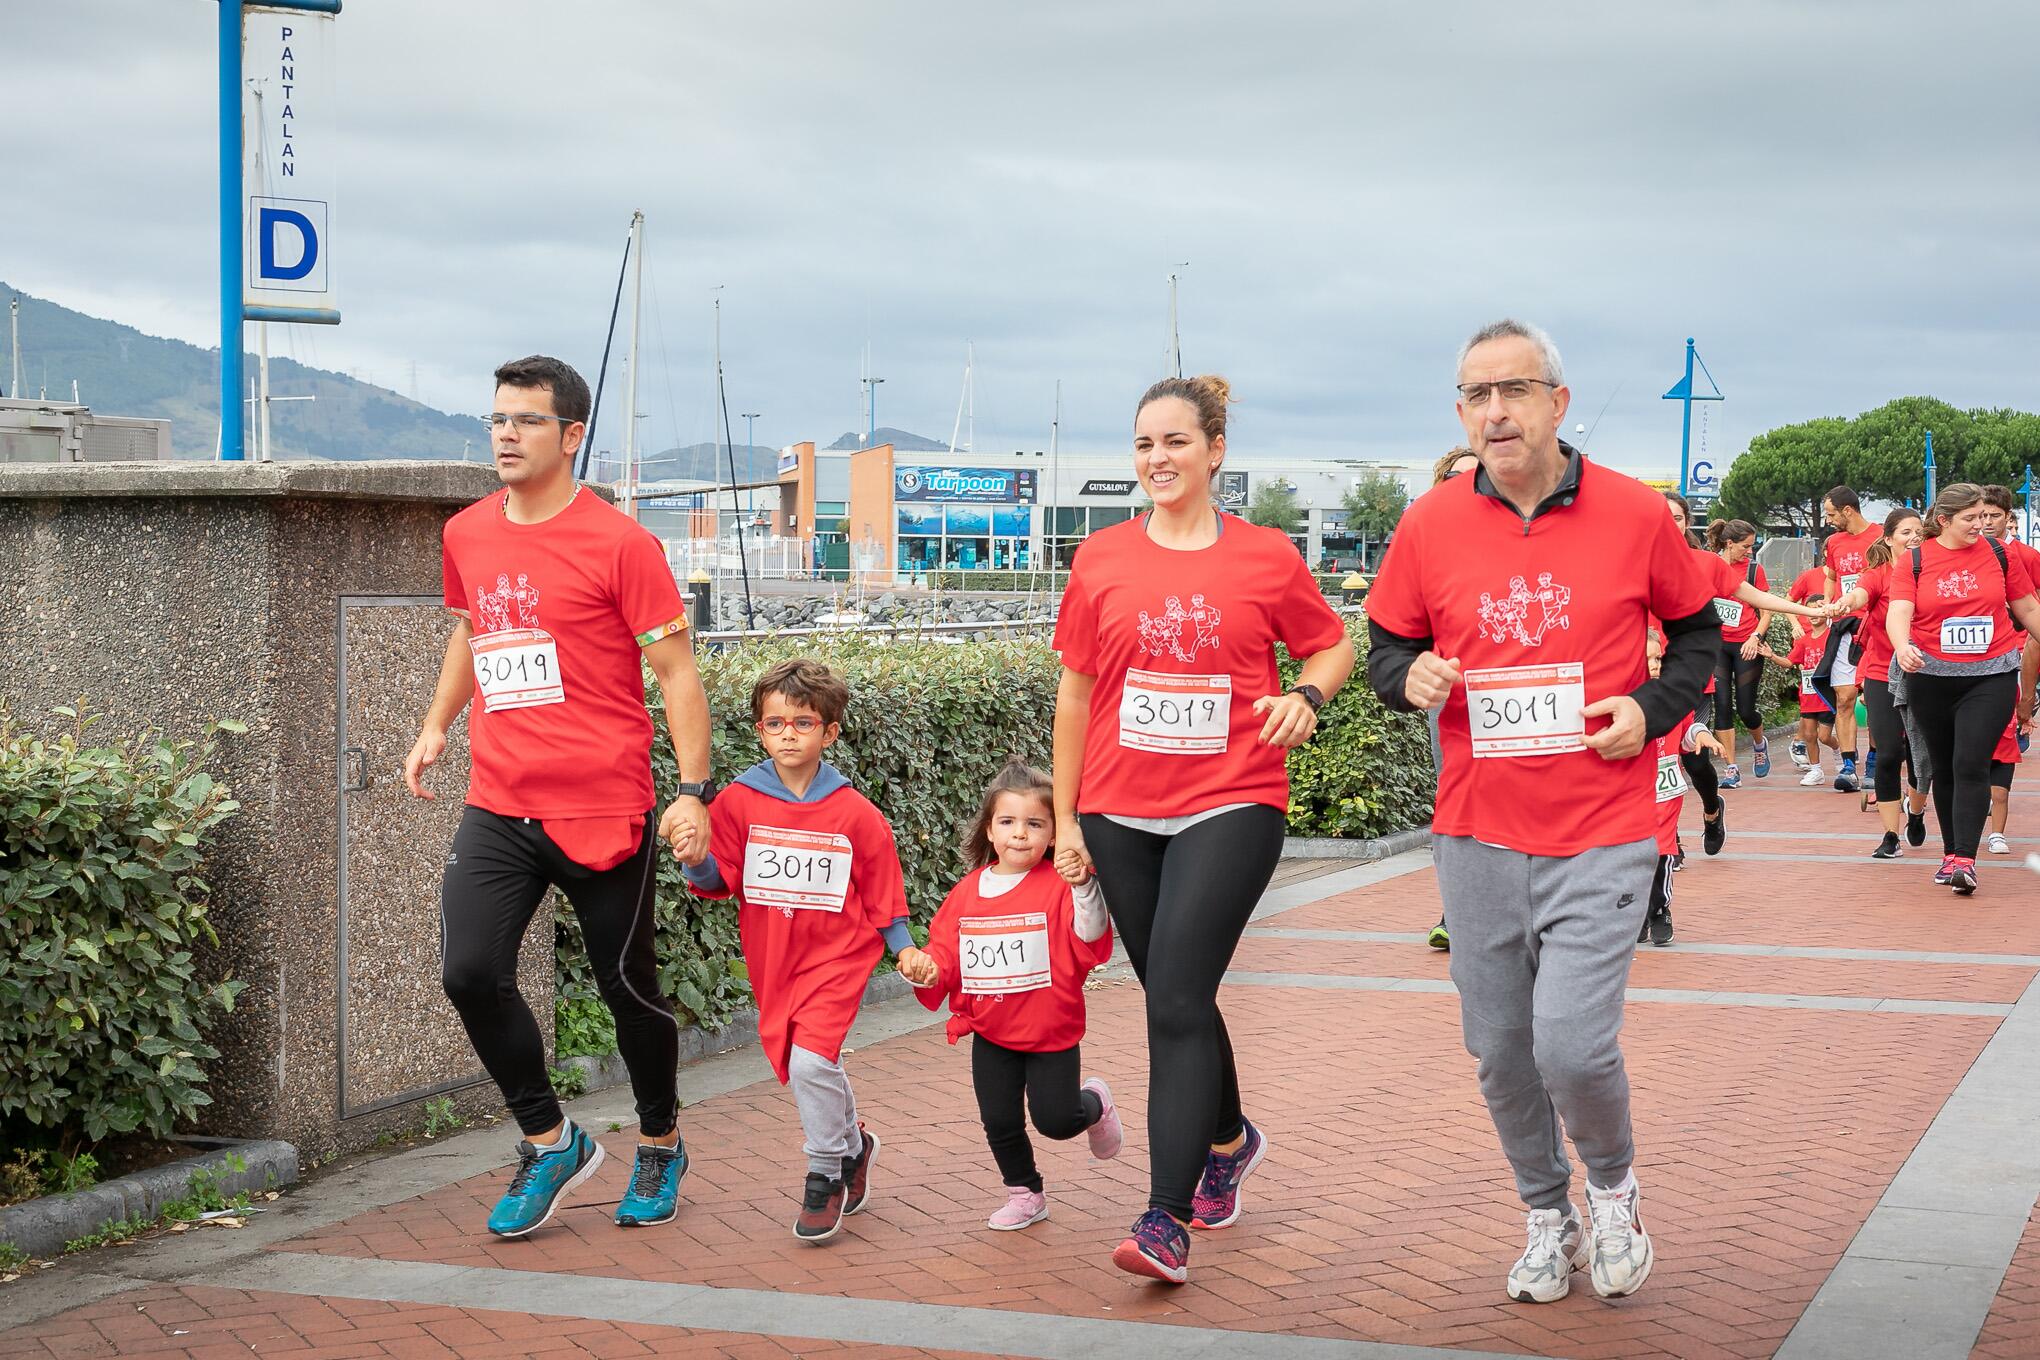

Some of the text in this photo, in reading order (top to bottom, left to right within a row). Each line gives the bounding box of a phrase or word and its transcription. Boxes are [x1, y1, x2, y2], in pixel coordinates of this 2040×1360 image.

[281, 26, 294, 177] PANTALAN
[260, 207, 318, 280] D
[926, 473, 1006, 494] Tarpoon
[1089, 483, 1129, 492] GUTS&LOVE
[1692, 461, 1713, 485] C
[1947, 627, 1987, 645] 1011
[478, 654, 547, 686] 3019
[1133, 694, 1215, 728] 3019
[1480, 692, 1557, 729] 3019
[757, 850, 832, 883] 3019
[965, 939, 1025, 969] 3019
